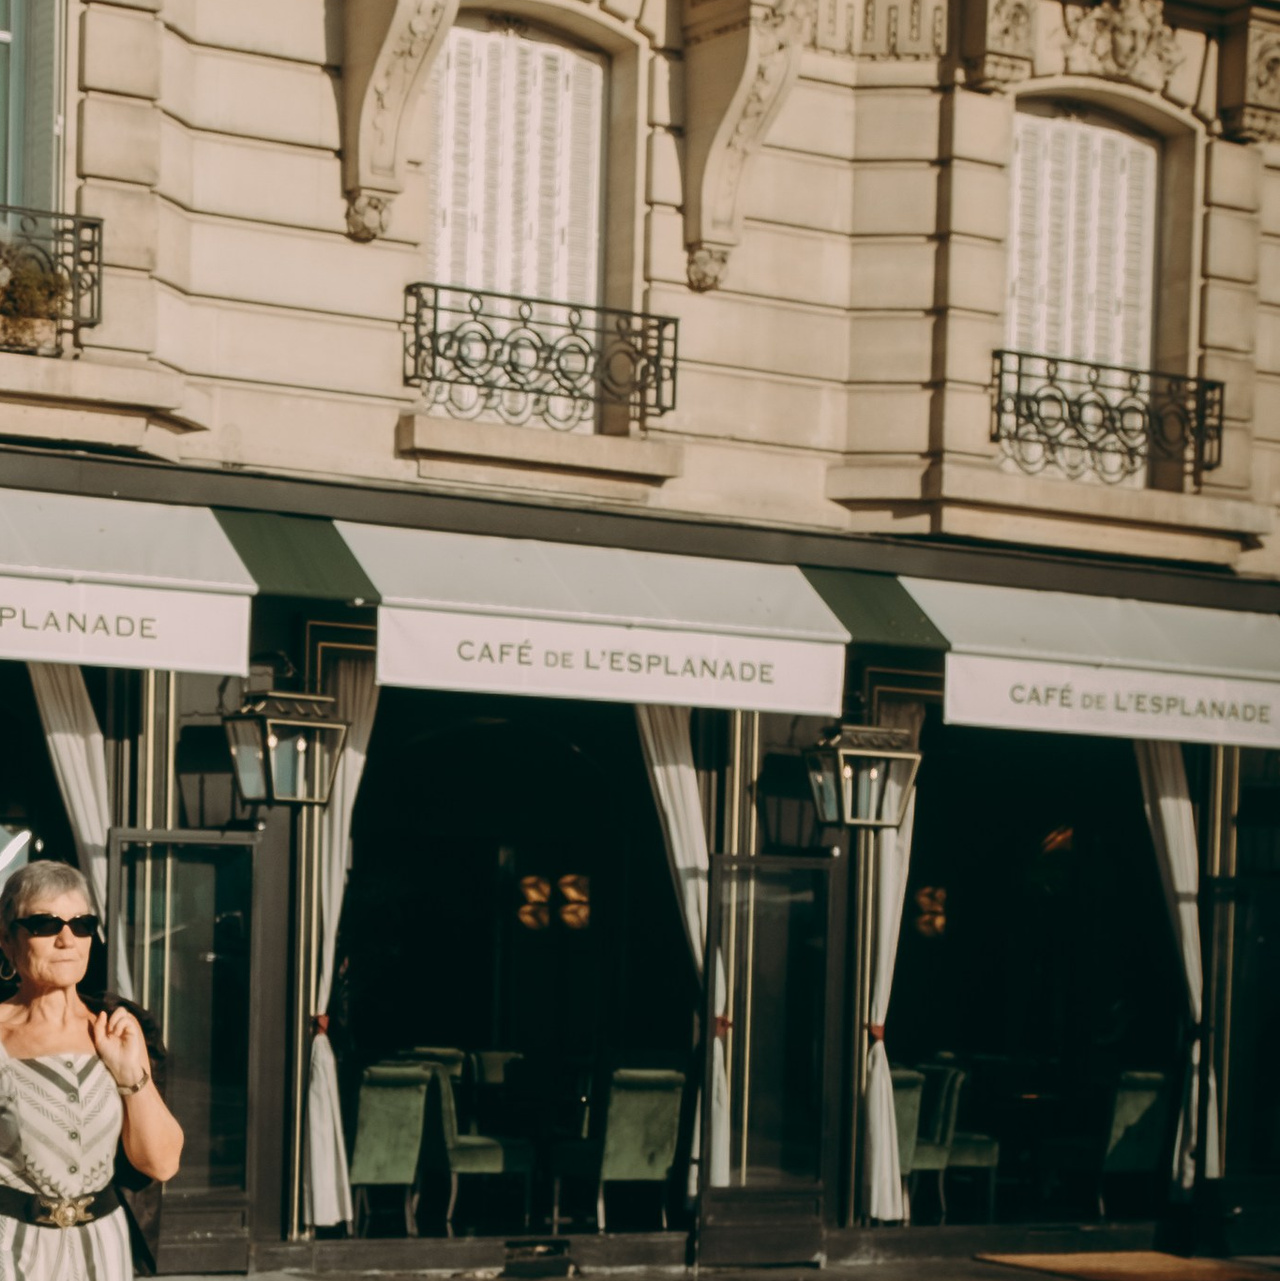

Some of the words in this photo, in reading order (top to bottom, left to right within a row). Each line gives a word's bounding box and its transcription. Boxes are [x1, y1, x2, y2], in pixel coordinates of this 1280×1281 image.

[456, 639, 533, 667] CAFÉ
[543, 650, 574, 670] DE
[584, 649, 774, 685] L'ESPLANADE
[1009, 683, 1073, 709] CAFÉ
[1080, 693, 1105, 711] DE
[1114, 693, 1271, 725] L'ESPLANADE
